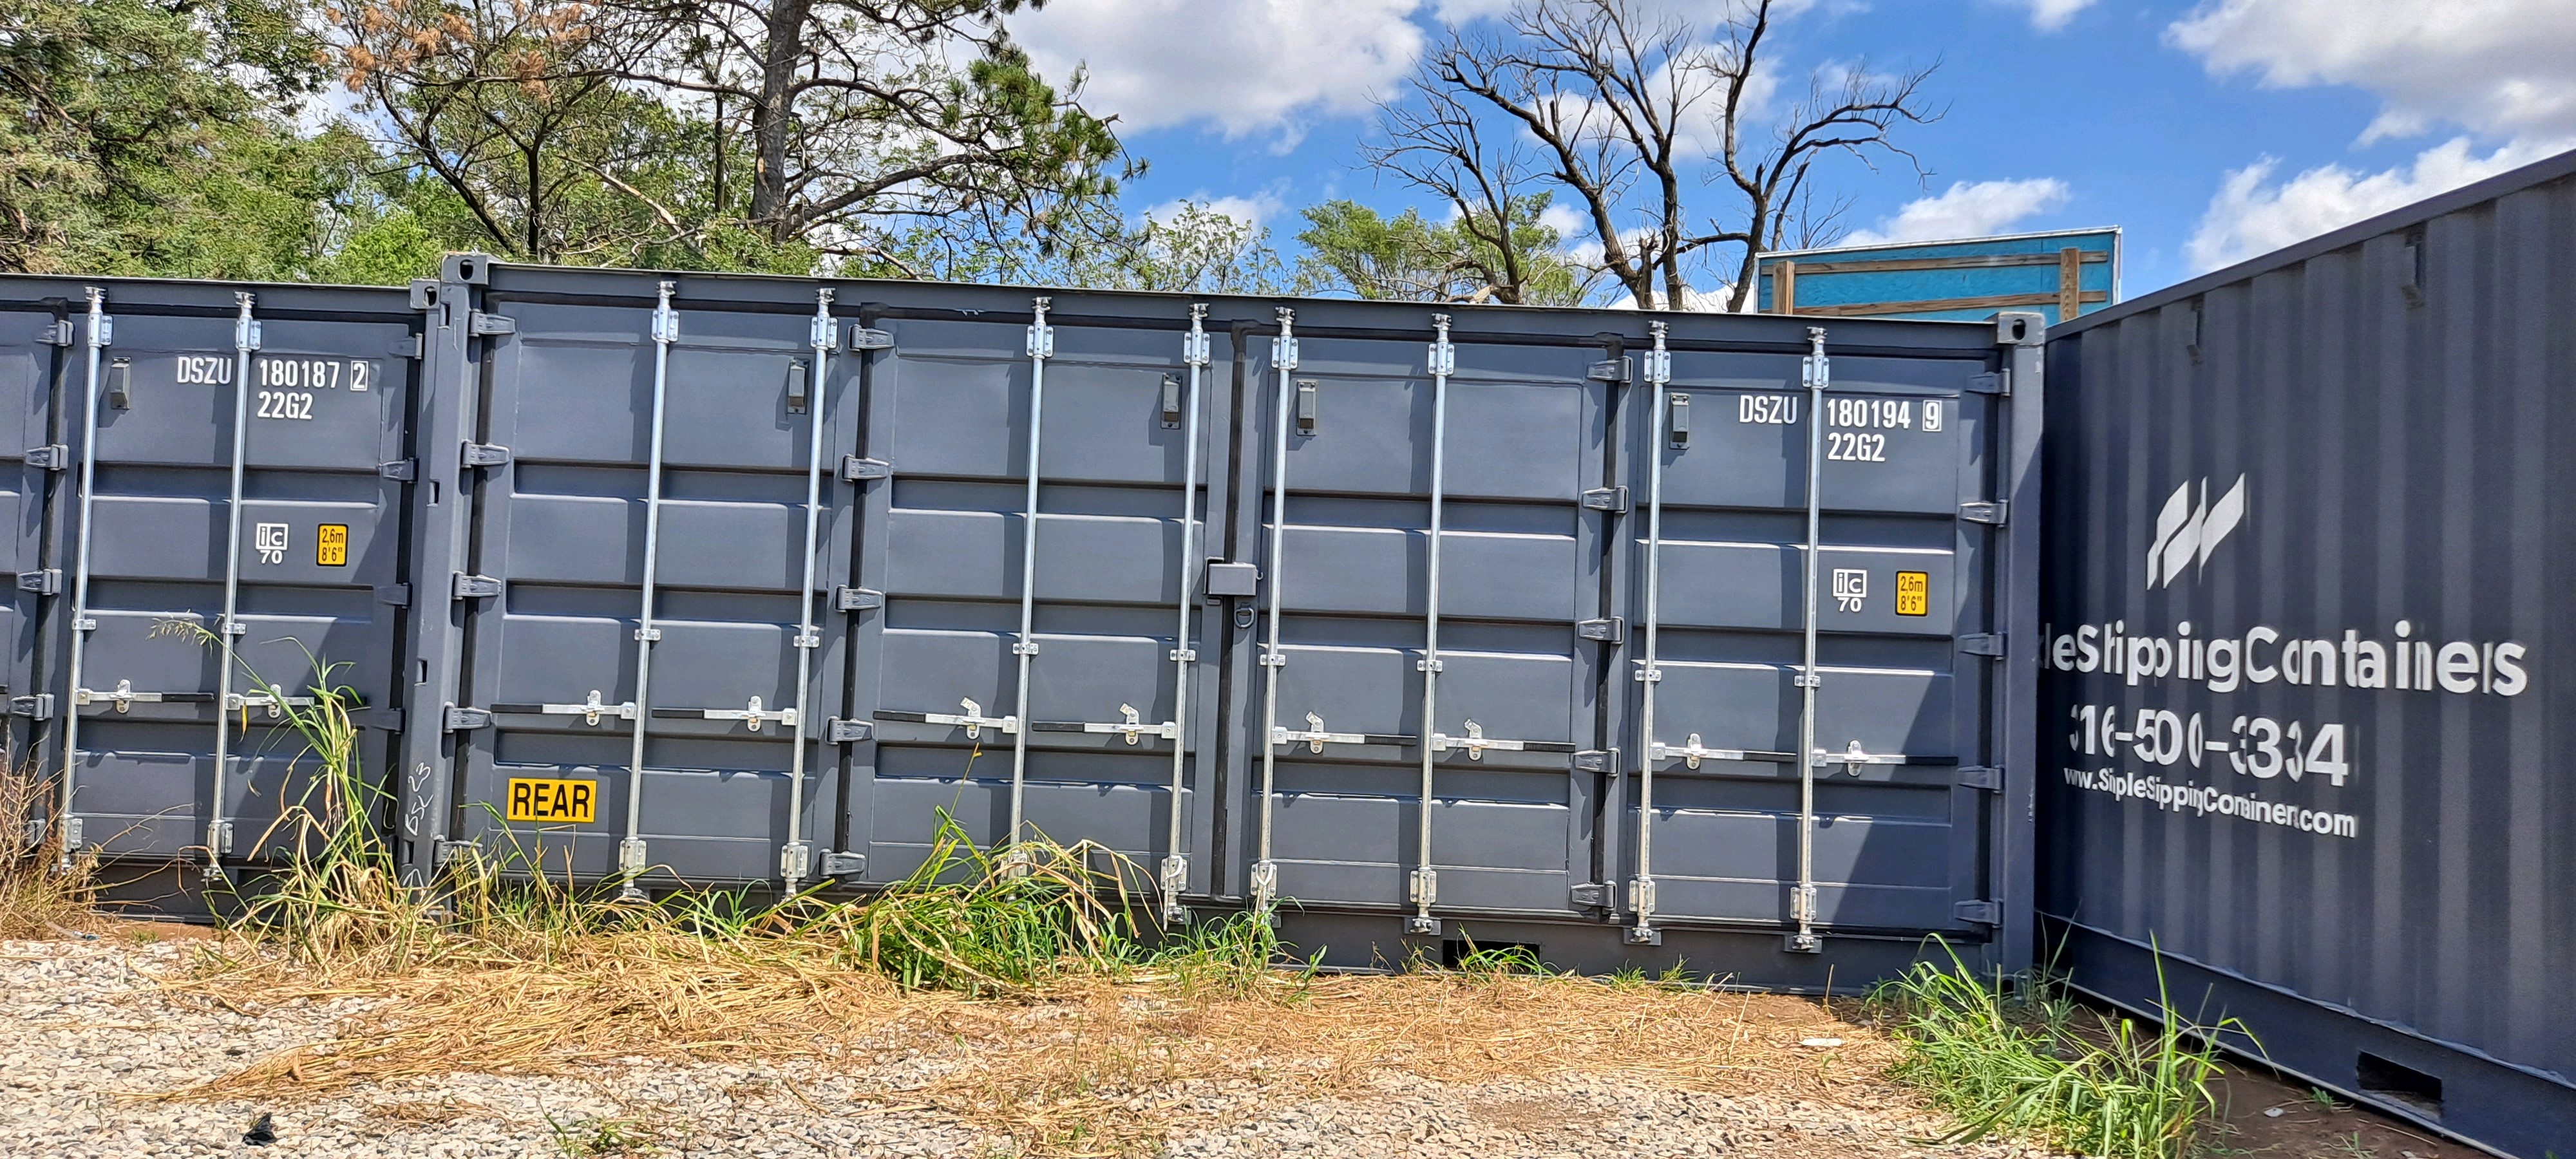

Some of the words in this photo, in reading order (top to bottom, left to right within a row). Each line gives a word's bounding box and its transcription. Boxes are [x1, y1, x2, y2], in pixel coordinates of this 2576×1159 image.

[176, 355, 232, 384] DSZU
[259, 359, 340, 389] 180187
[352, 362, 366, 390] 2
[257, 390, 314, 420] 22G2
[1739, 394, 1798, 425] DSZU
[1826, 398, 1911, 429] 180194
[1924, 401, 1940, 429] 9
[1827, 432, 1886, 462] 22G2
[322, 527, 344, 546] 2,6m
[260, 549, 283, 564] 70
[321, 547, 343, 562] 8'6"
[1900, 575, 1923, 595] 2,6m
[1837, 596, 1862, 612] 70
[1900, 595, 1922, 612] 8'6"
[513, 782, 591, 818] REAR
